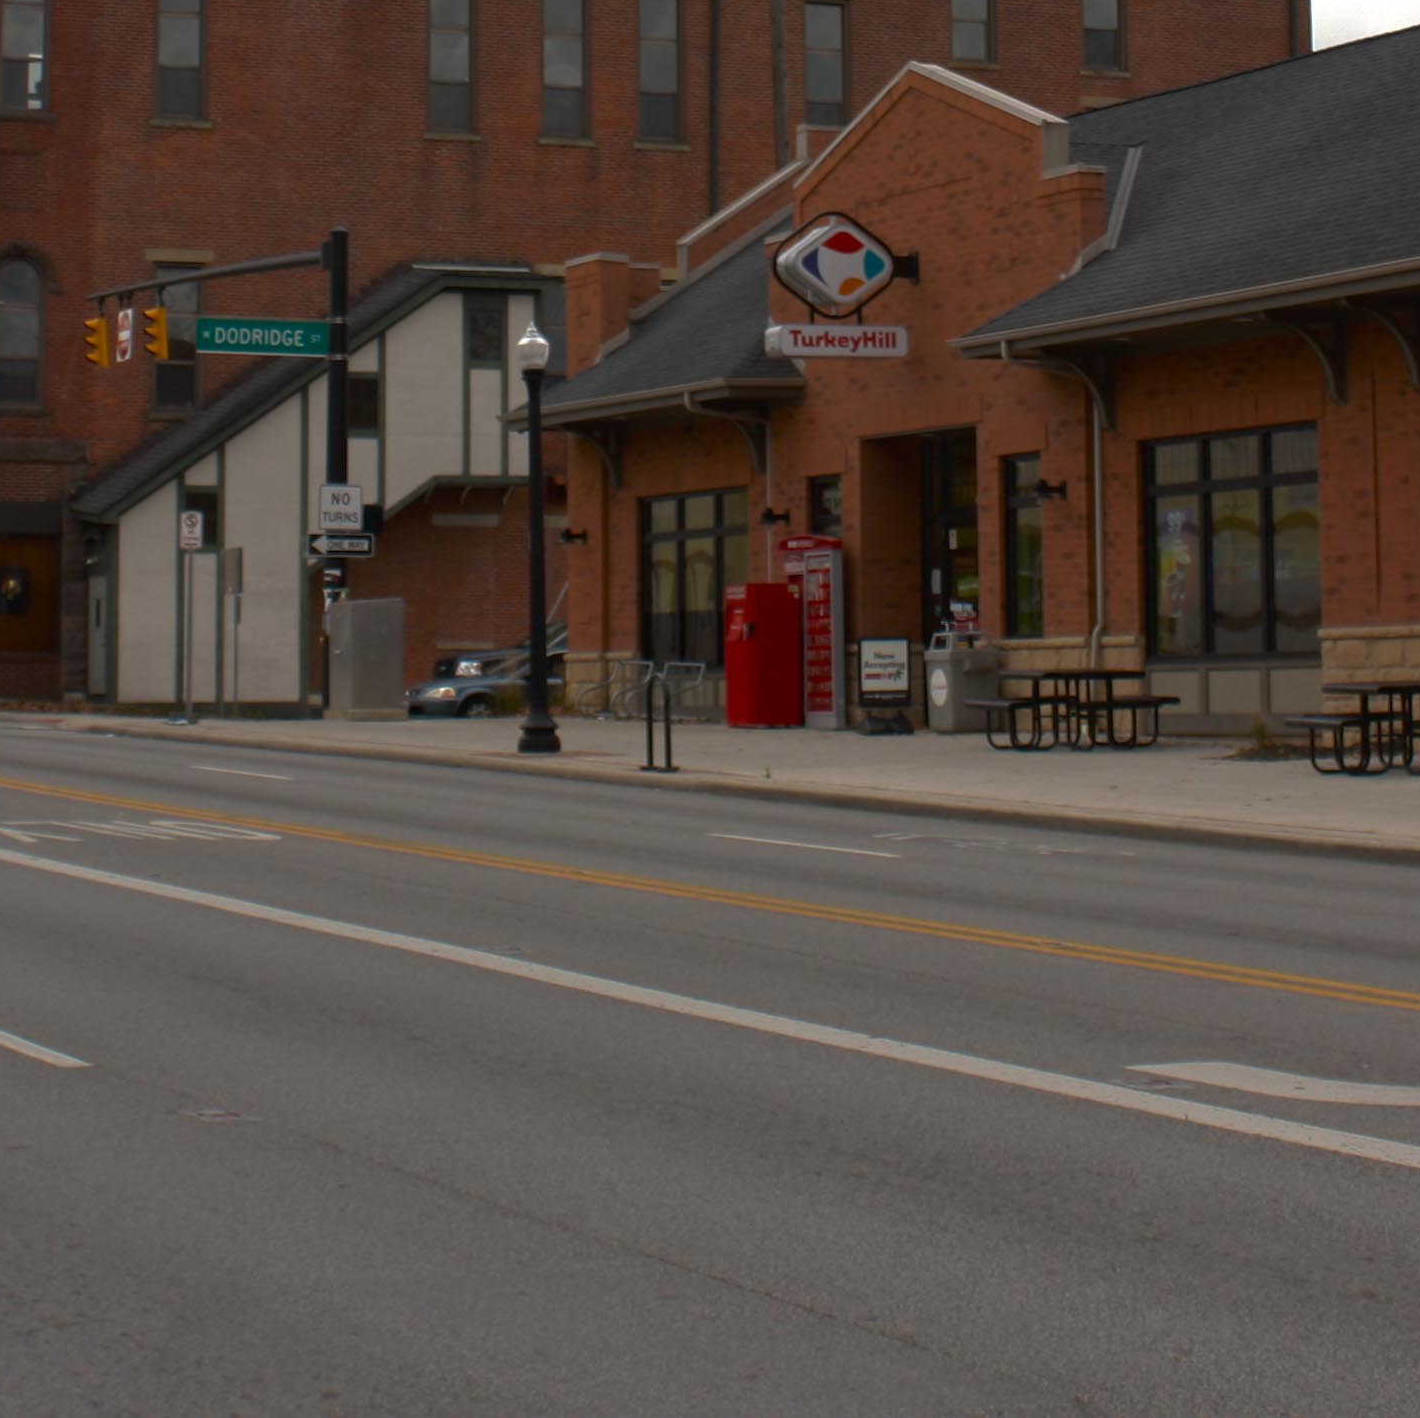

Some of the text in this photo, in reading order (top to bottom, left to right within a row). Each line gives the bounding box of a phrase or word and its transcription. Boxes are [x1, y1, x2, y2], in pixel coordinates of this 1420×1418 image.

[214, 326, 305, 348] DODRIDGE
[789, 329, 897, 353] TurkeyHill
[330, 492, 351, 506] NO
[322, 511, 359, 524] TURNS
